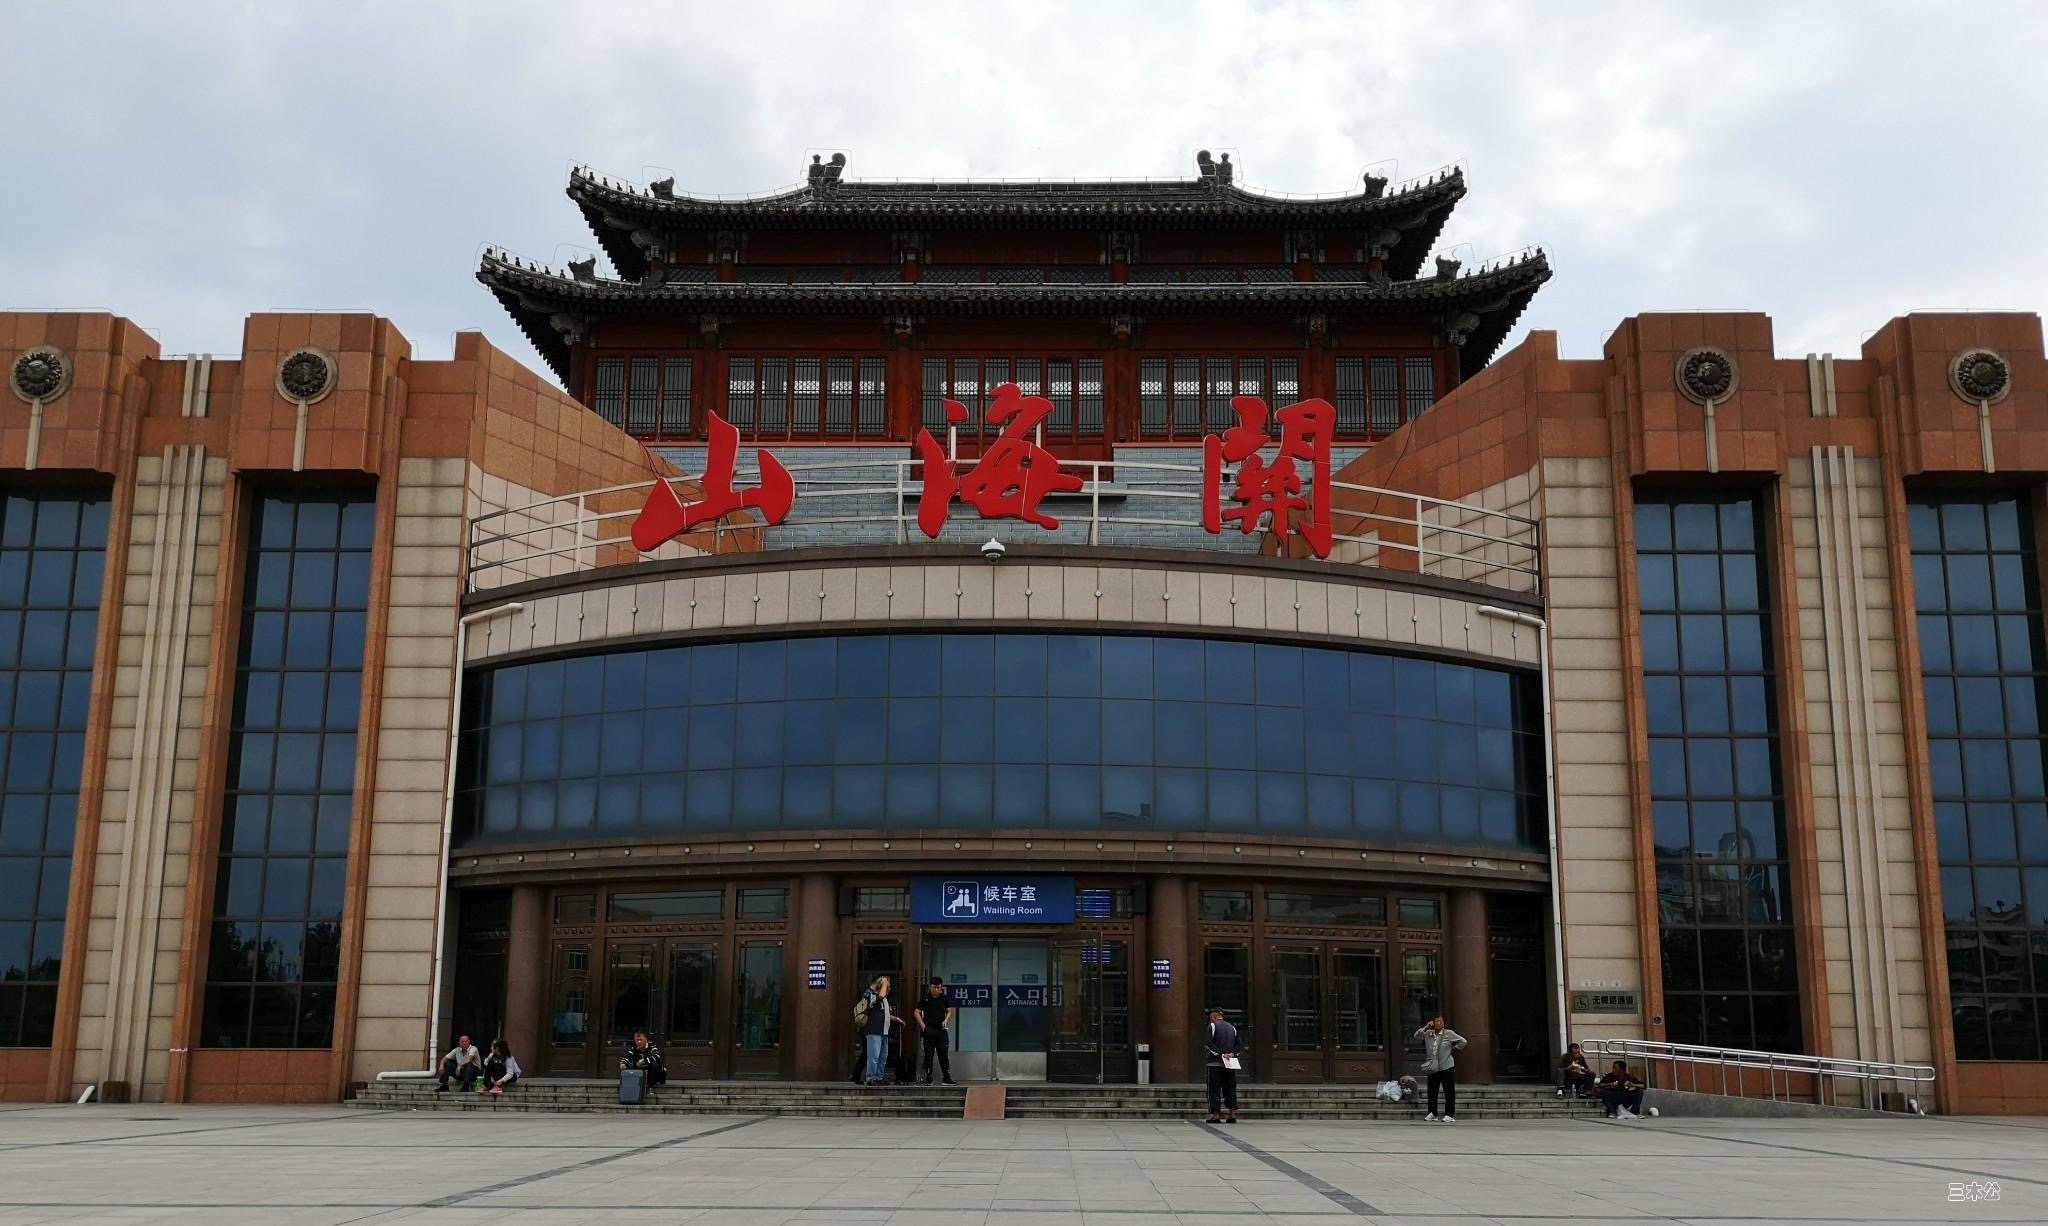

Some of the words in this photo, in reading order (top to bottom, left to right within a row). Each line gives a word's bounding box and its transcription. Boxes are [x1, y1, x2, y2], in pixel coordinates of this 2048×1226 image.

[983, 885, 1036, 902] 候车室
[983, 906, 1015, 916] Waiting
[1017, 906, 1043, 915] Room
[954, 987, 989, 1000] 出口
[1005, 988, 1040, 1000] 入口
[1007, 999, 1039, 1007] ENTRANCE
